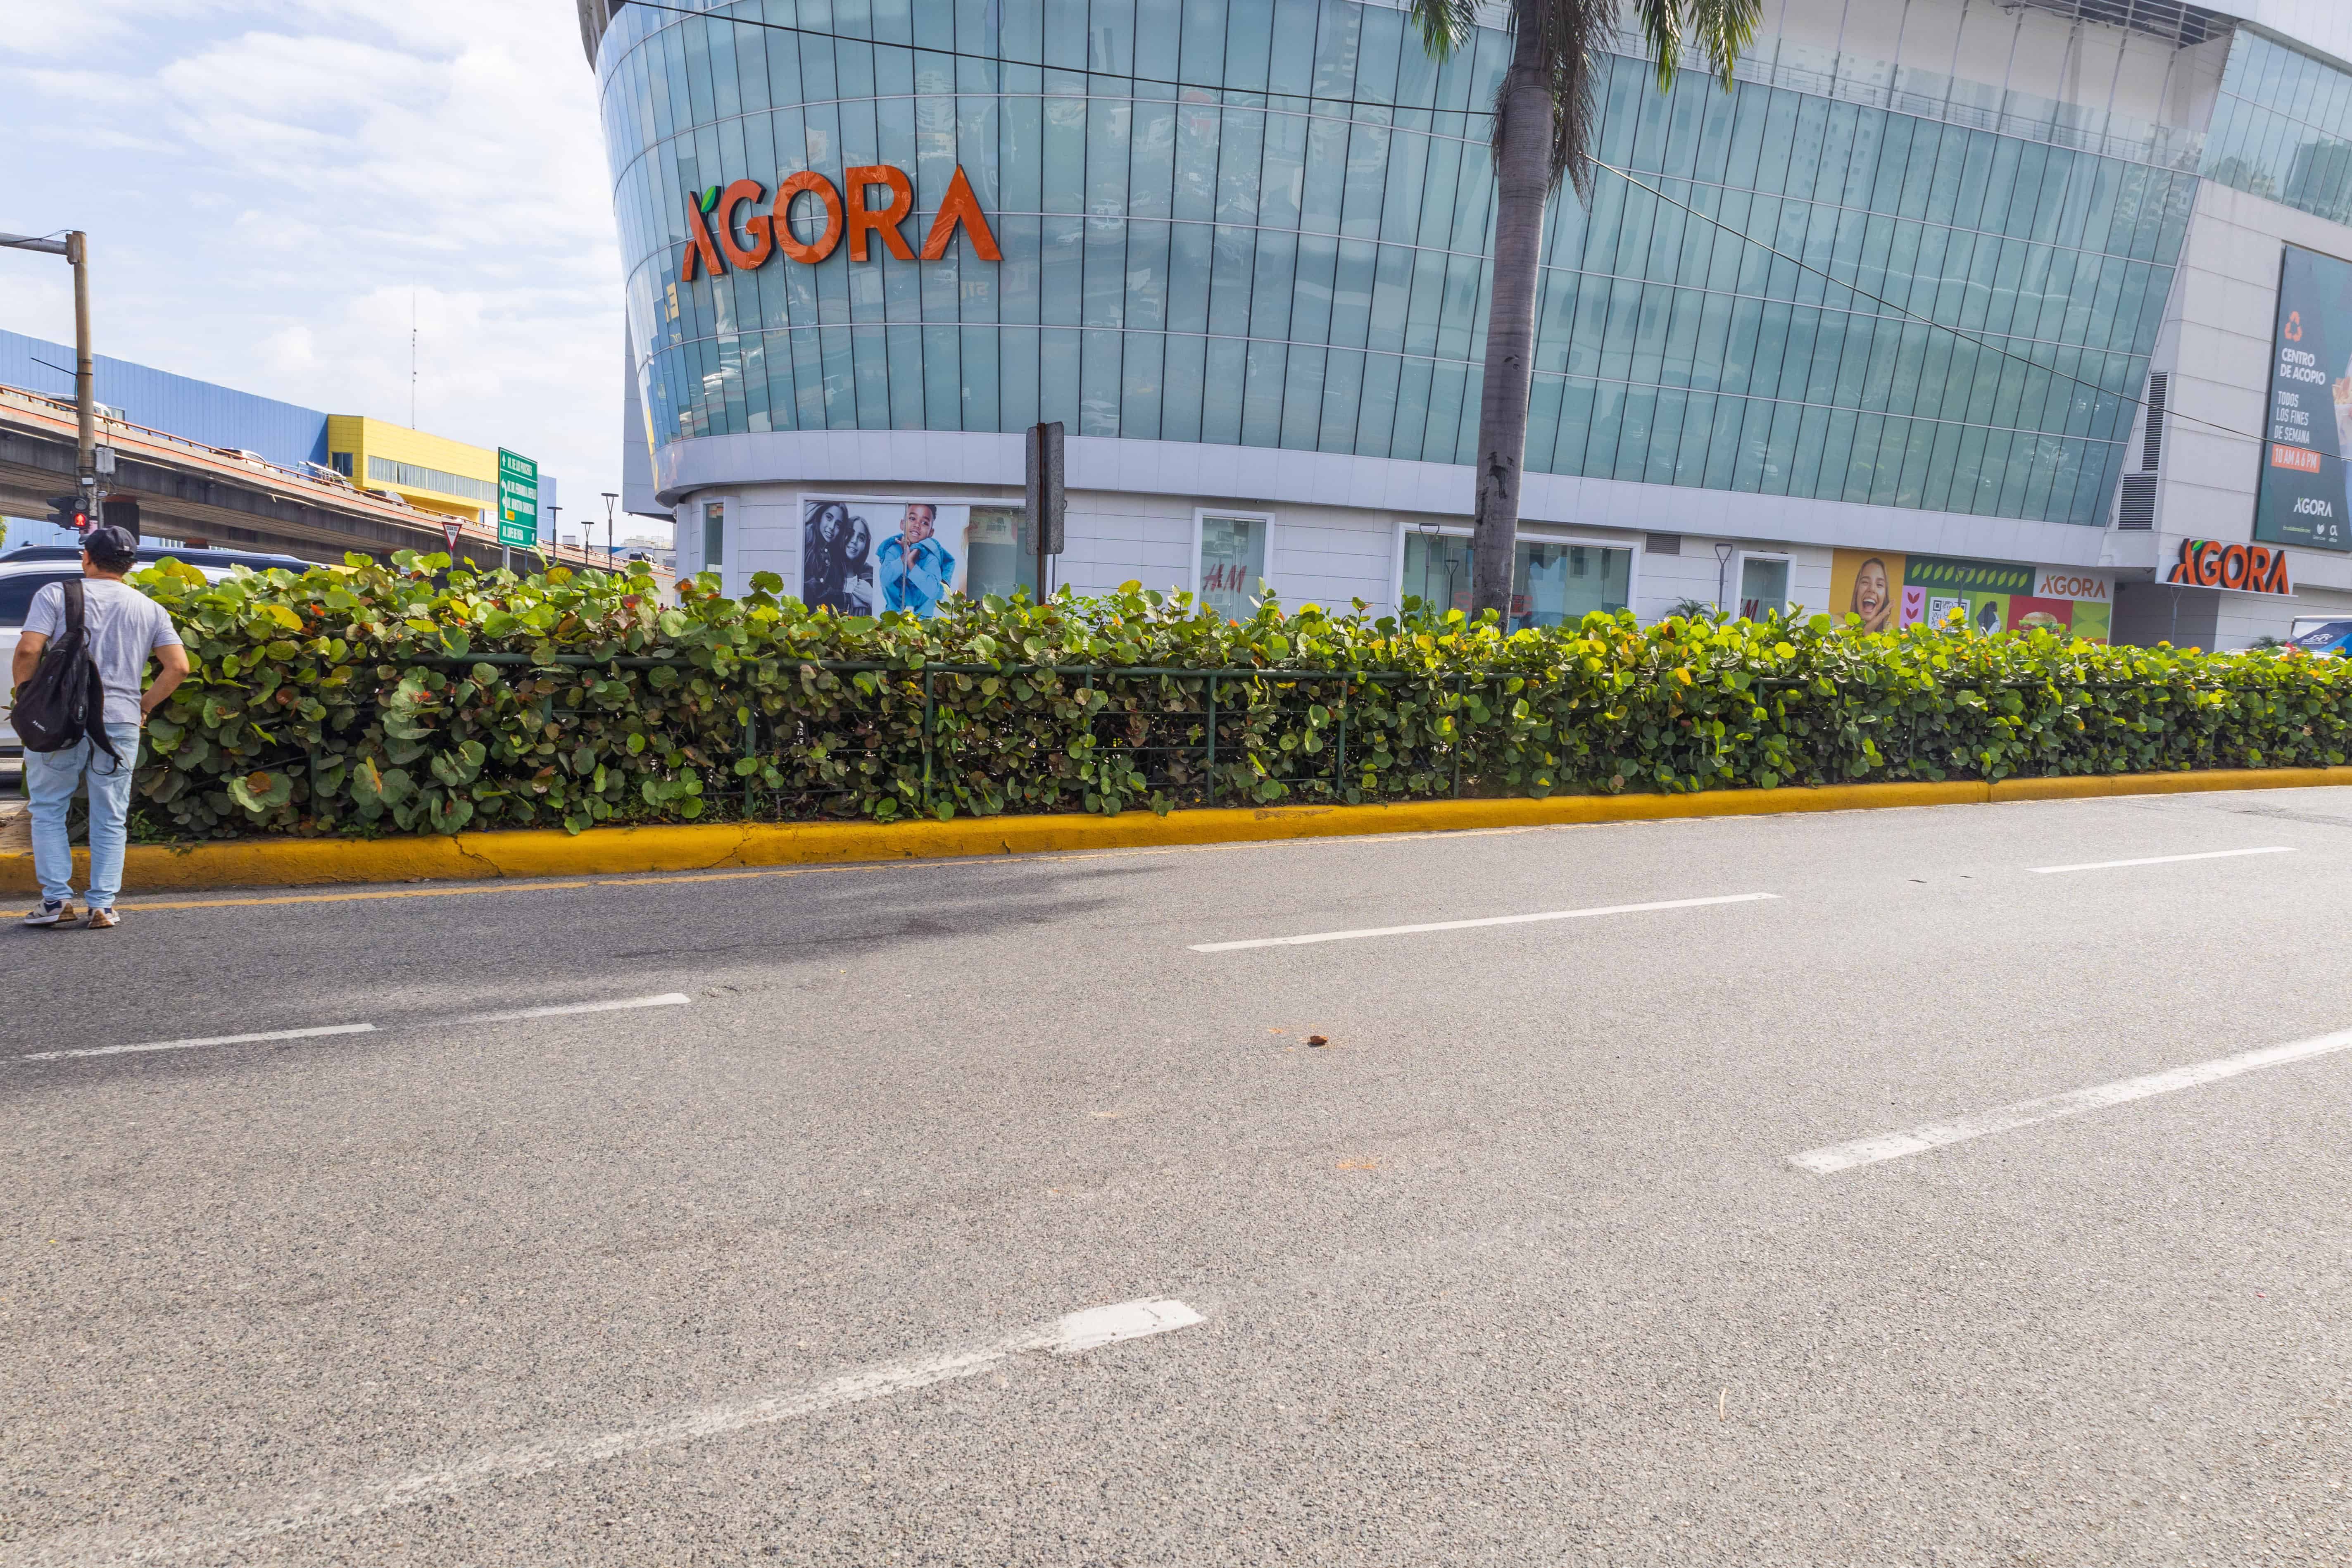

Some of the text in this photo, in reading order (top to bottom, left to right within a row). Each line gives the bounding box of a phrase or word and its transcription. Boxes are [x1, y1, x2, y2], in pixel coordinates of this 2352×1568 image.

[2281, 348, 2315, 367] CENTRO
[2280, 363, 2326, 385] DE ACOPIO
[2278, 390, 2299, 407] TODOS
[2276, 407, 2309, 426] LOS FINES
[2274, 425, 2310, 444] DE SEMANA
[2275, 447, 2317, 469] 10 AM A 6 PM
